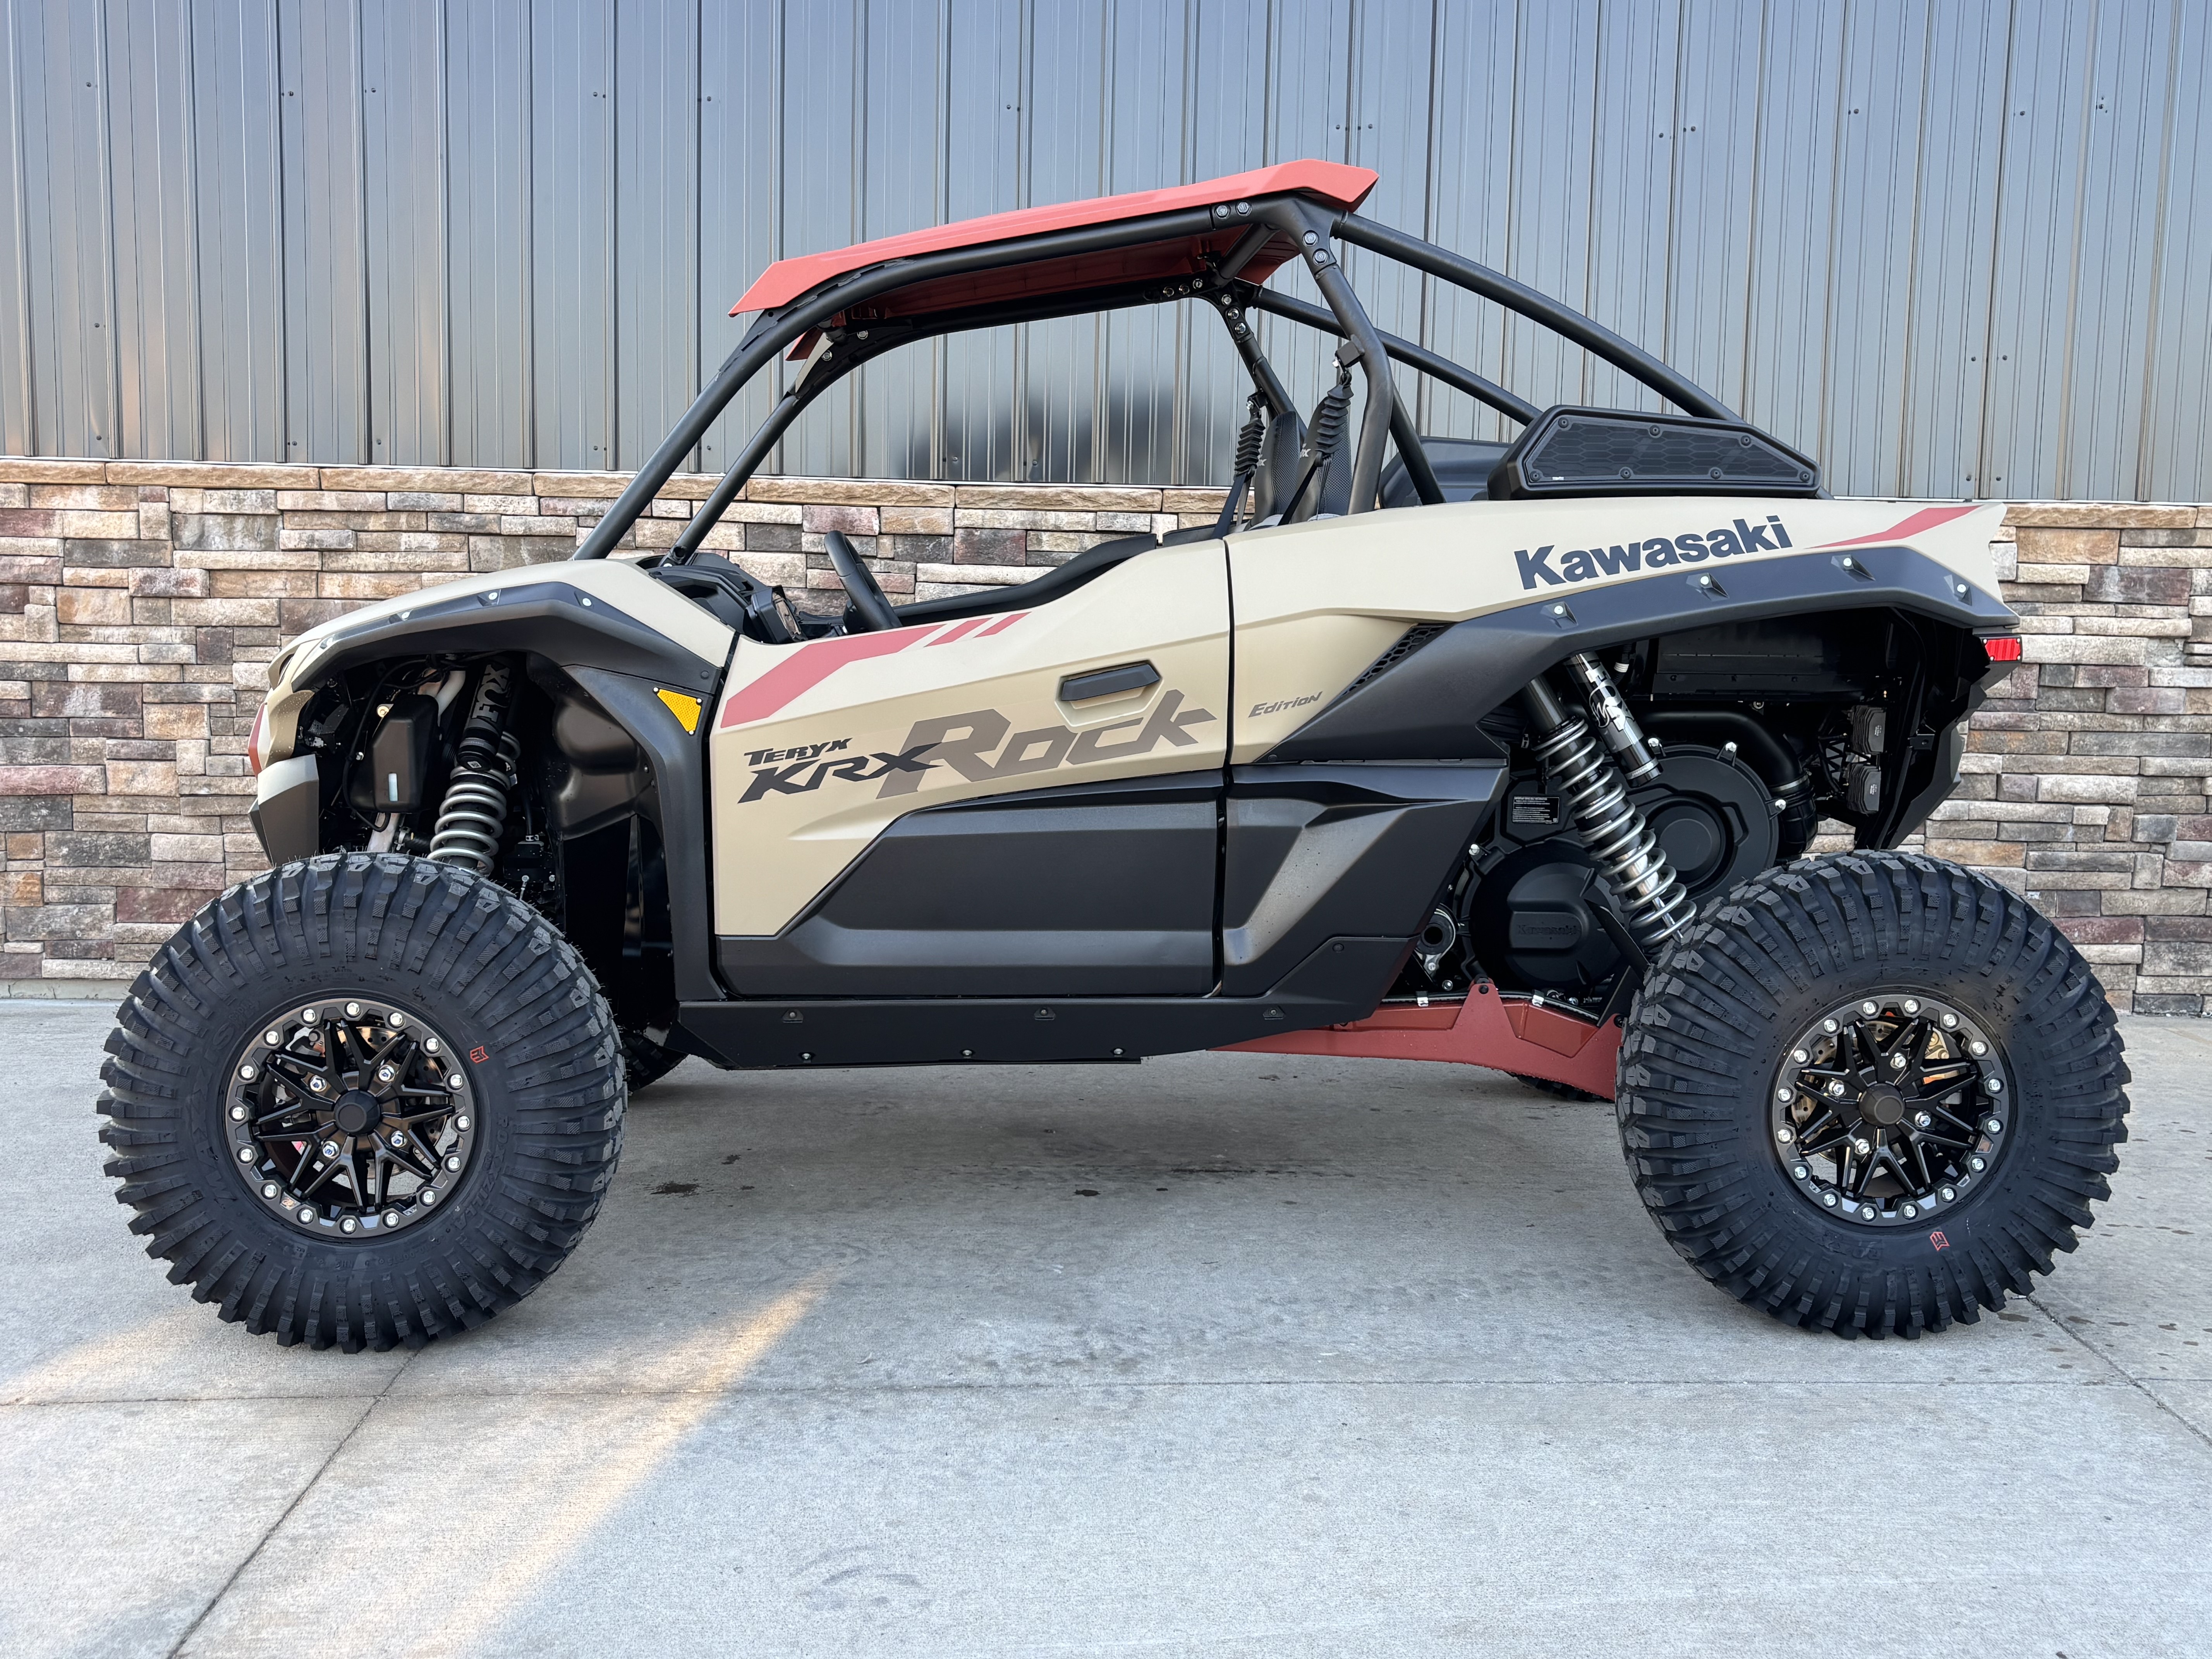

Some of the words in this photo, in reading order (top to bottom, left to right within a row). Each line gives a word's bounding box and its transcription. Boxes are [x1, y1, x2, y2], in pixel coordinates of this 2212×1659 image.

[1514, 515, 1793, 590] Kawasaki
[472, 662, 510, 723] FOX
[1248, 691, 1323, 718] Edition
[737, 742, 943, 804] KRX
